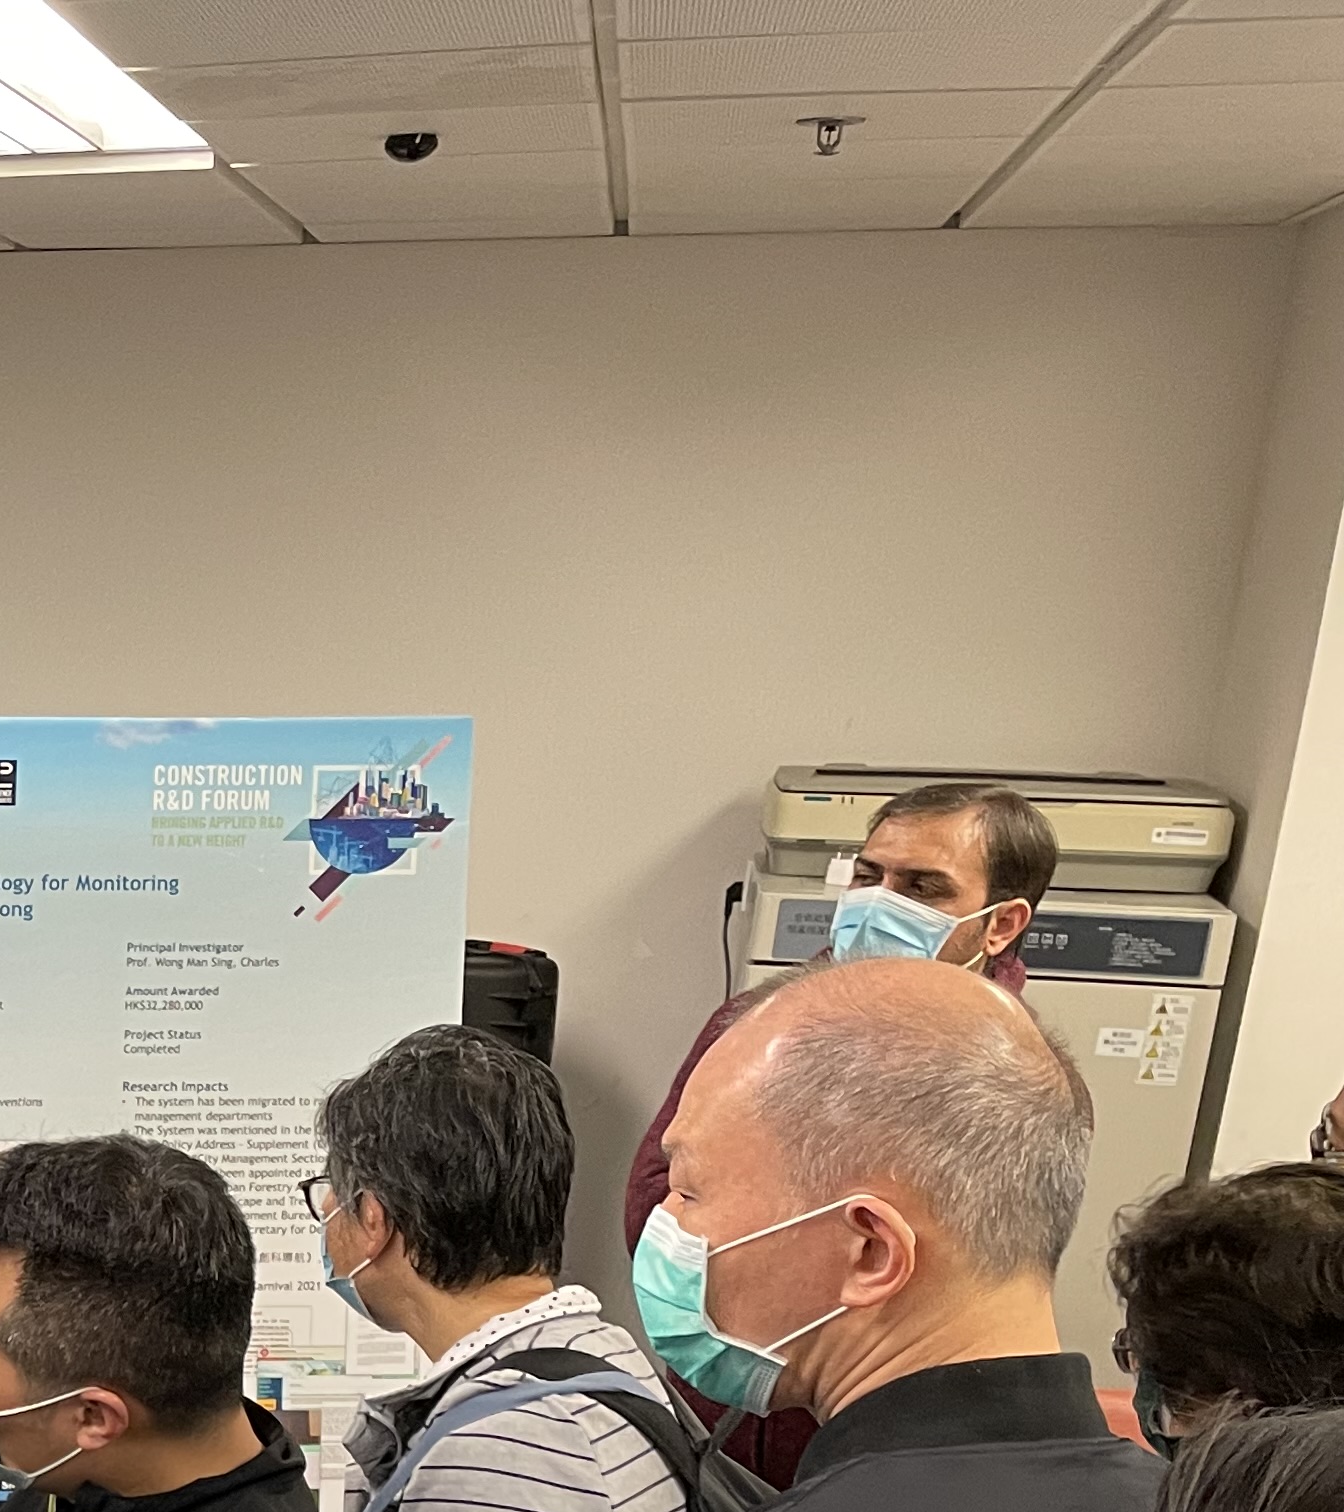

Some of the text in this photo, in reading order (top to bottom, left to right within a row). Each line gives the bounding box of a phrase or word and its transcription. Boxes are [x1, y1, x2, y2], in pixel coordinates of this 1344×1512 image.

[154, 765, 303, 786] CONSTRUCTION
[152, 790, 270, 811] R&D FORUM
[151, 816, 284, 829] BRIDGING APPLIED R&D
[152, 834, 247, 847] TO A NEW HEIGHT
[41, 873, 69, 891] for
[76, 874, 179, 895] Monitoring
[126, 942, 244, 955] Principal Investigator
[126, 957, 151, 968] Prof.
[155, 957, 184, 969] Wong
[186, 957, 208, 967] Man
[240, 957, 280, 968] Charles
[125, 986, 220, 997] Amount Awarded
[124, 1030, 202, 1041] Project Status
[123, 1044, 181, 1056] Completed
[122, 1081, 229, 1094] Research Impacts
[135, 1096, 155, 1107] The
[157, 1097, 195, 1109] system
[197, 1096, 216, 1107] has
[218, 1096, 245, 1107] been
[247, 1096, 296, 1109] migrated
[298, 1097, 311, 1107] to
[134, 1111, 273, 1123] management departments
[134, 1125, 312, 1137] The System was mentioned in the
[195, 1139, 236, 1150] Address
[246, 1139, 310, 1151] Supplement
[221, 1154, 289, 1166] Management
[291, 1153, 328, 1164] Sectio
[248, 1168, 302, 1180] appointed
[248, 1182, 292, 1194] Forestry
[265, 1197, 286, 1206] and
[289, 1196, 306, 1206] Tre
[290, 1225, 306, 1235] for
[256, 1280, 321, 1291] arnival 2021
